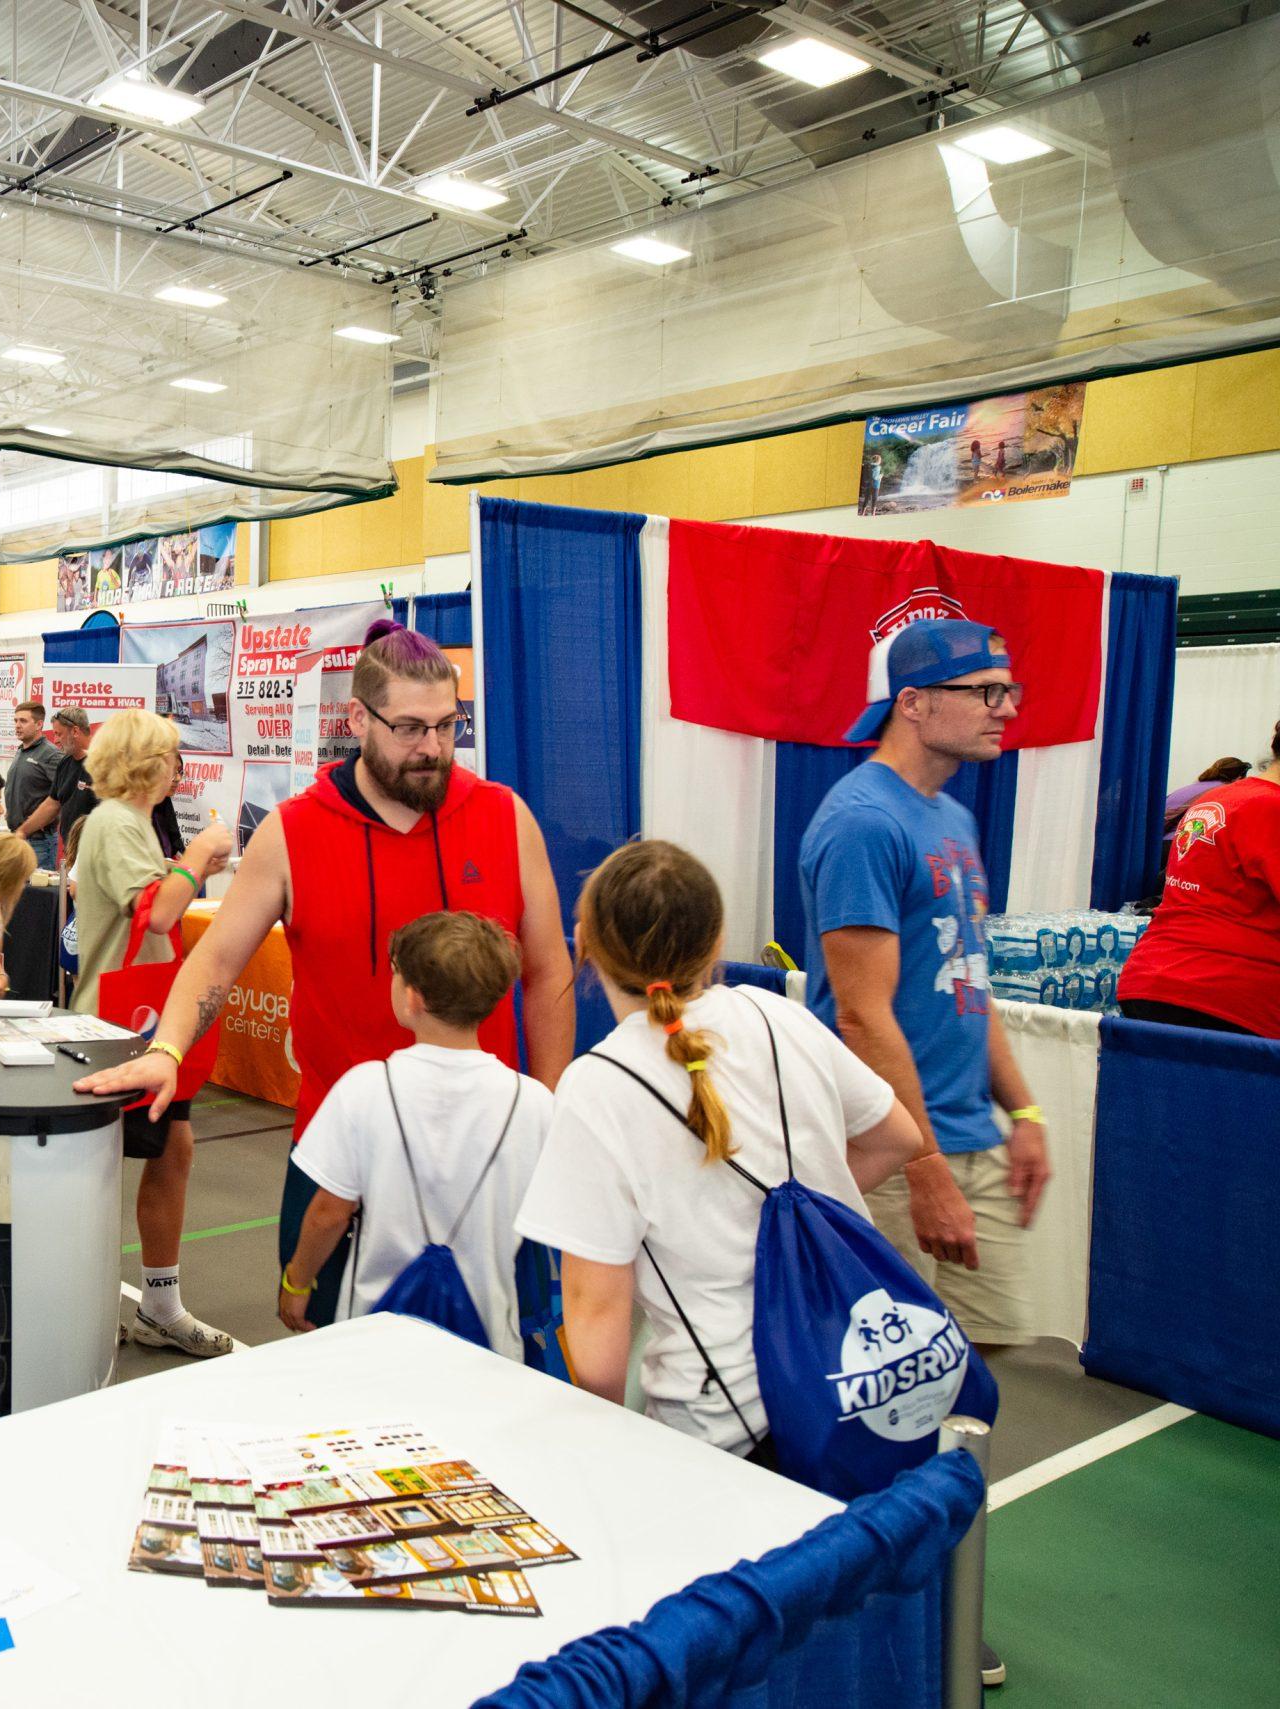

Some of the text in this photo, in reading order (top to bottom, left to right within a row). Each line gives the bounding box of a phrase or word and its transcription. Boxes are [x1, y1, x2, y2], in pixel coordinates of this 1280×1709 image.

[868, 411, 965, 436] Career Fair
[241, 624, 312, 653] Upstate
[240, 656, 273, 675] Spray
[276, 654, 297, 670] Foa
[52, 681, 113, 698] Upstate
[238, 680, 293, 699] 315 822-5
[55, 698, 142, 709] Spray Foam & HVAC
[245, 704, 273, 716] Serving
[275, 704, 285, 713] All
[257, 720, 292, 737] OVER
[248, 745, 269, 756] Detail
[275, 746, 292, 757] Dete
[184, 763, 224, 781] ATION!
[177, 781, 205, 799] uality?
[227, 984, 289, 1023] ayuga
[225, 1015, 280, 1043] centers
[146, 1275, 179, 1288] VANS
